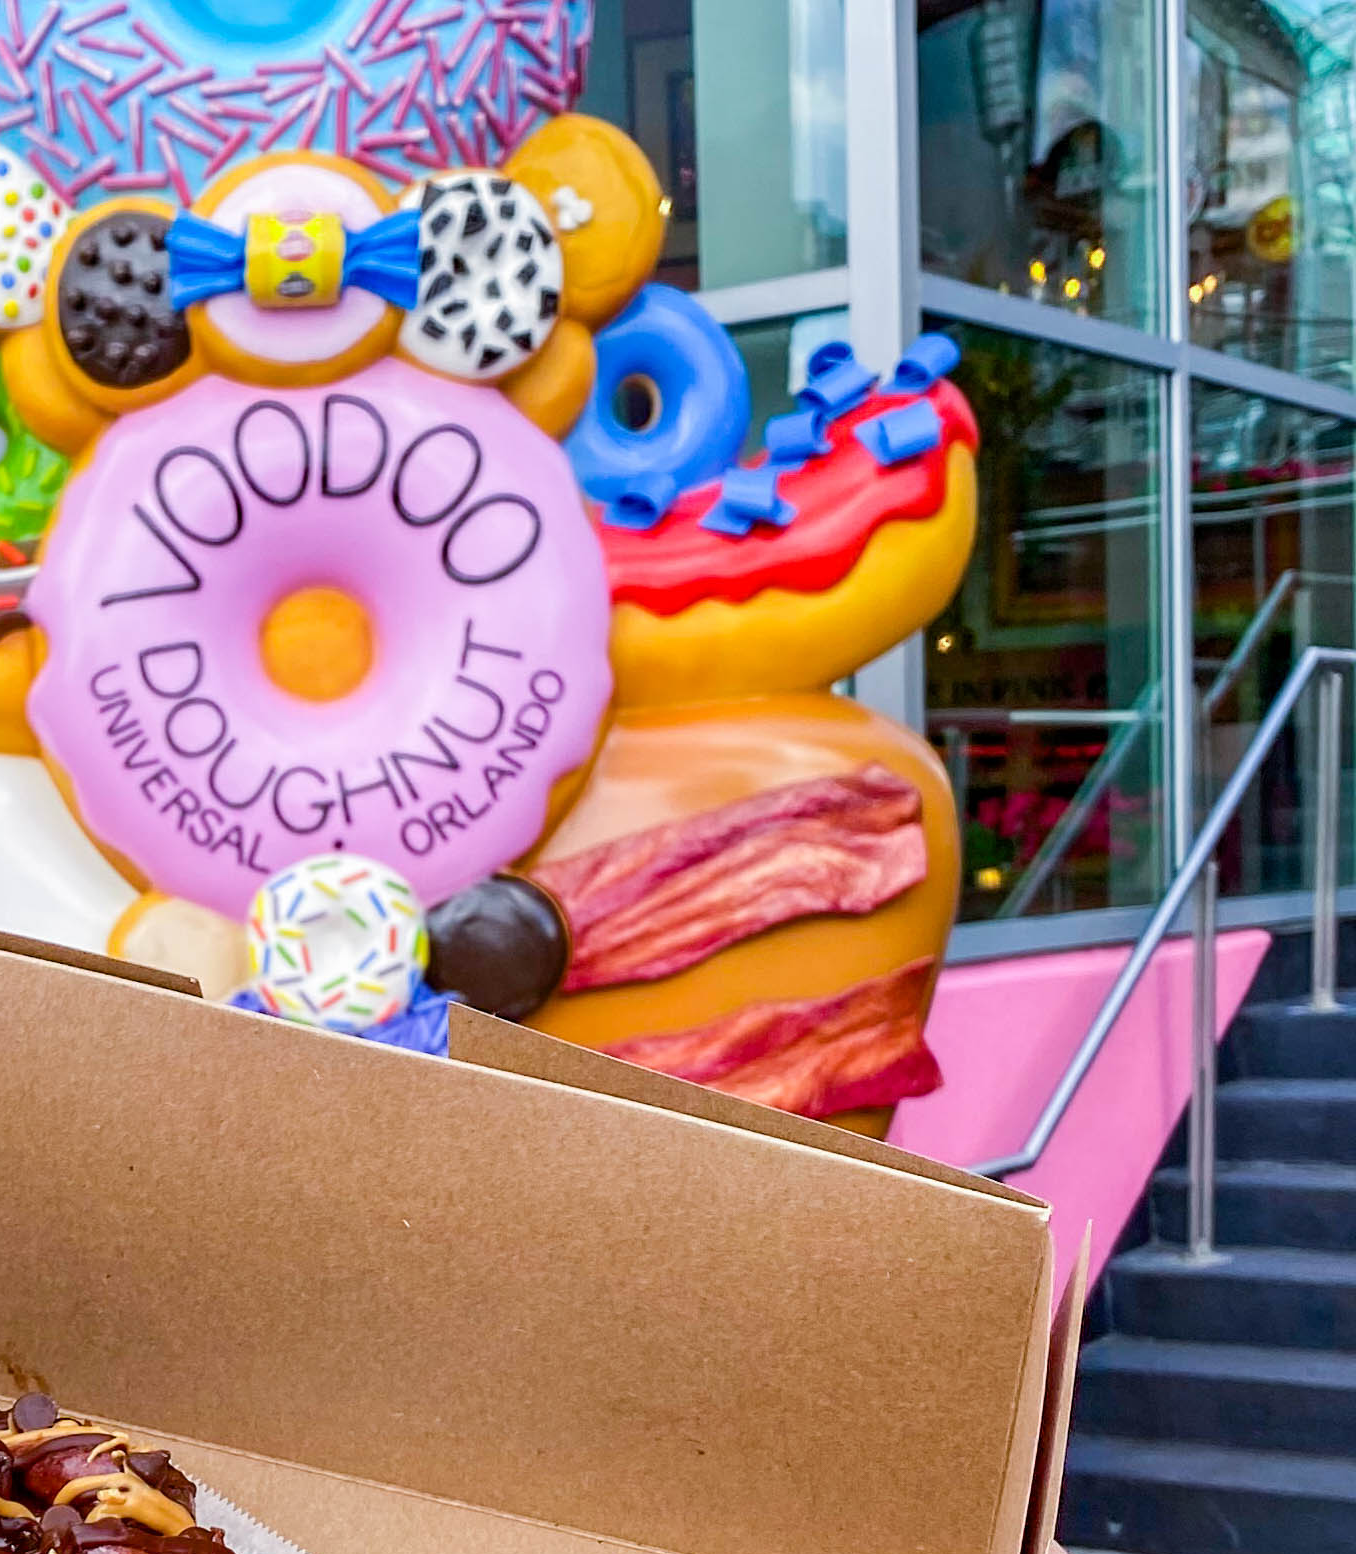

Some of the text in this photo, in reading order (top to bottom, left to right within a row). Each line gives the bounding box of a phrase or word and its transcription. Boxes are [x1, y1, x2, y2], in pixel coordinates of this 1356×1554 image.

[100, 393, 542, 608] VOODOO
[90, 664, 565, 874] UNIVERSAL ORLANDO
[138, 619, 523, 836] DOUGHNUT
